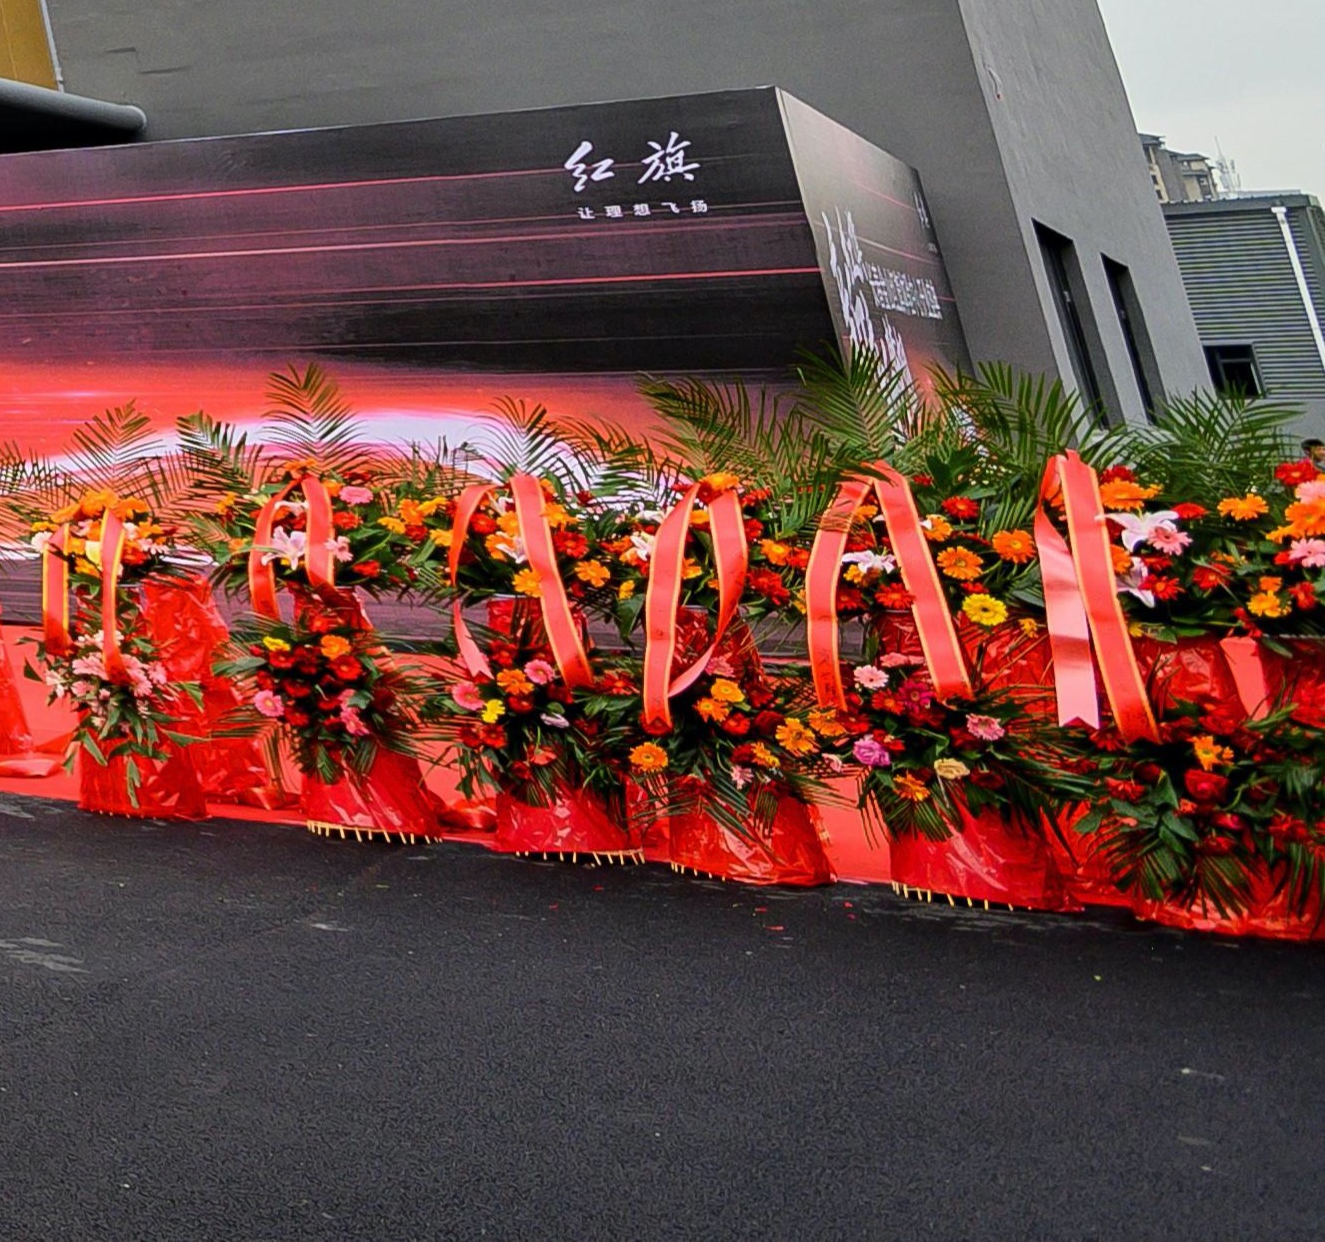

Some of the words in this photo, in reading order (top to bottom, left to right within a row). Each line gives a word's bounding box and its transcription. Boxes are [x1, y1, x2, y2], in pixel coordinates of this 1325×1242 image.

[563, 131, 701, 193] 红旗
[577, 199, 708, 220] 让理想飞扬
